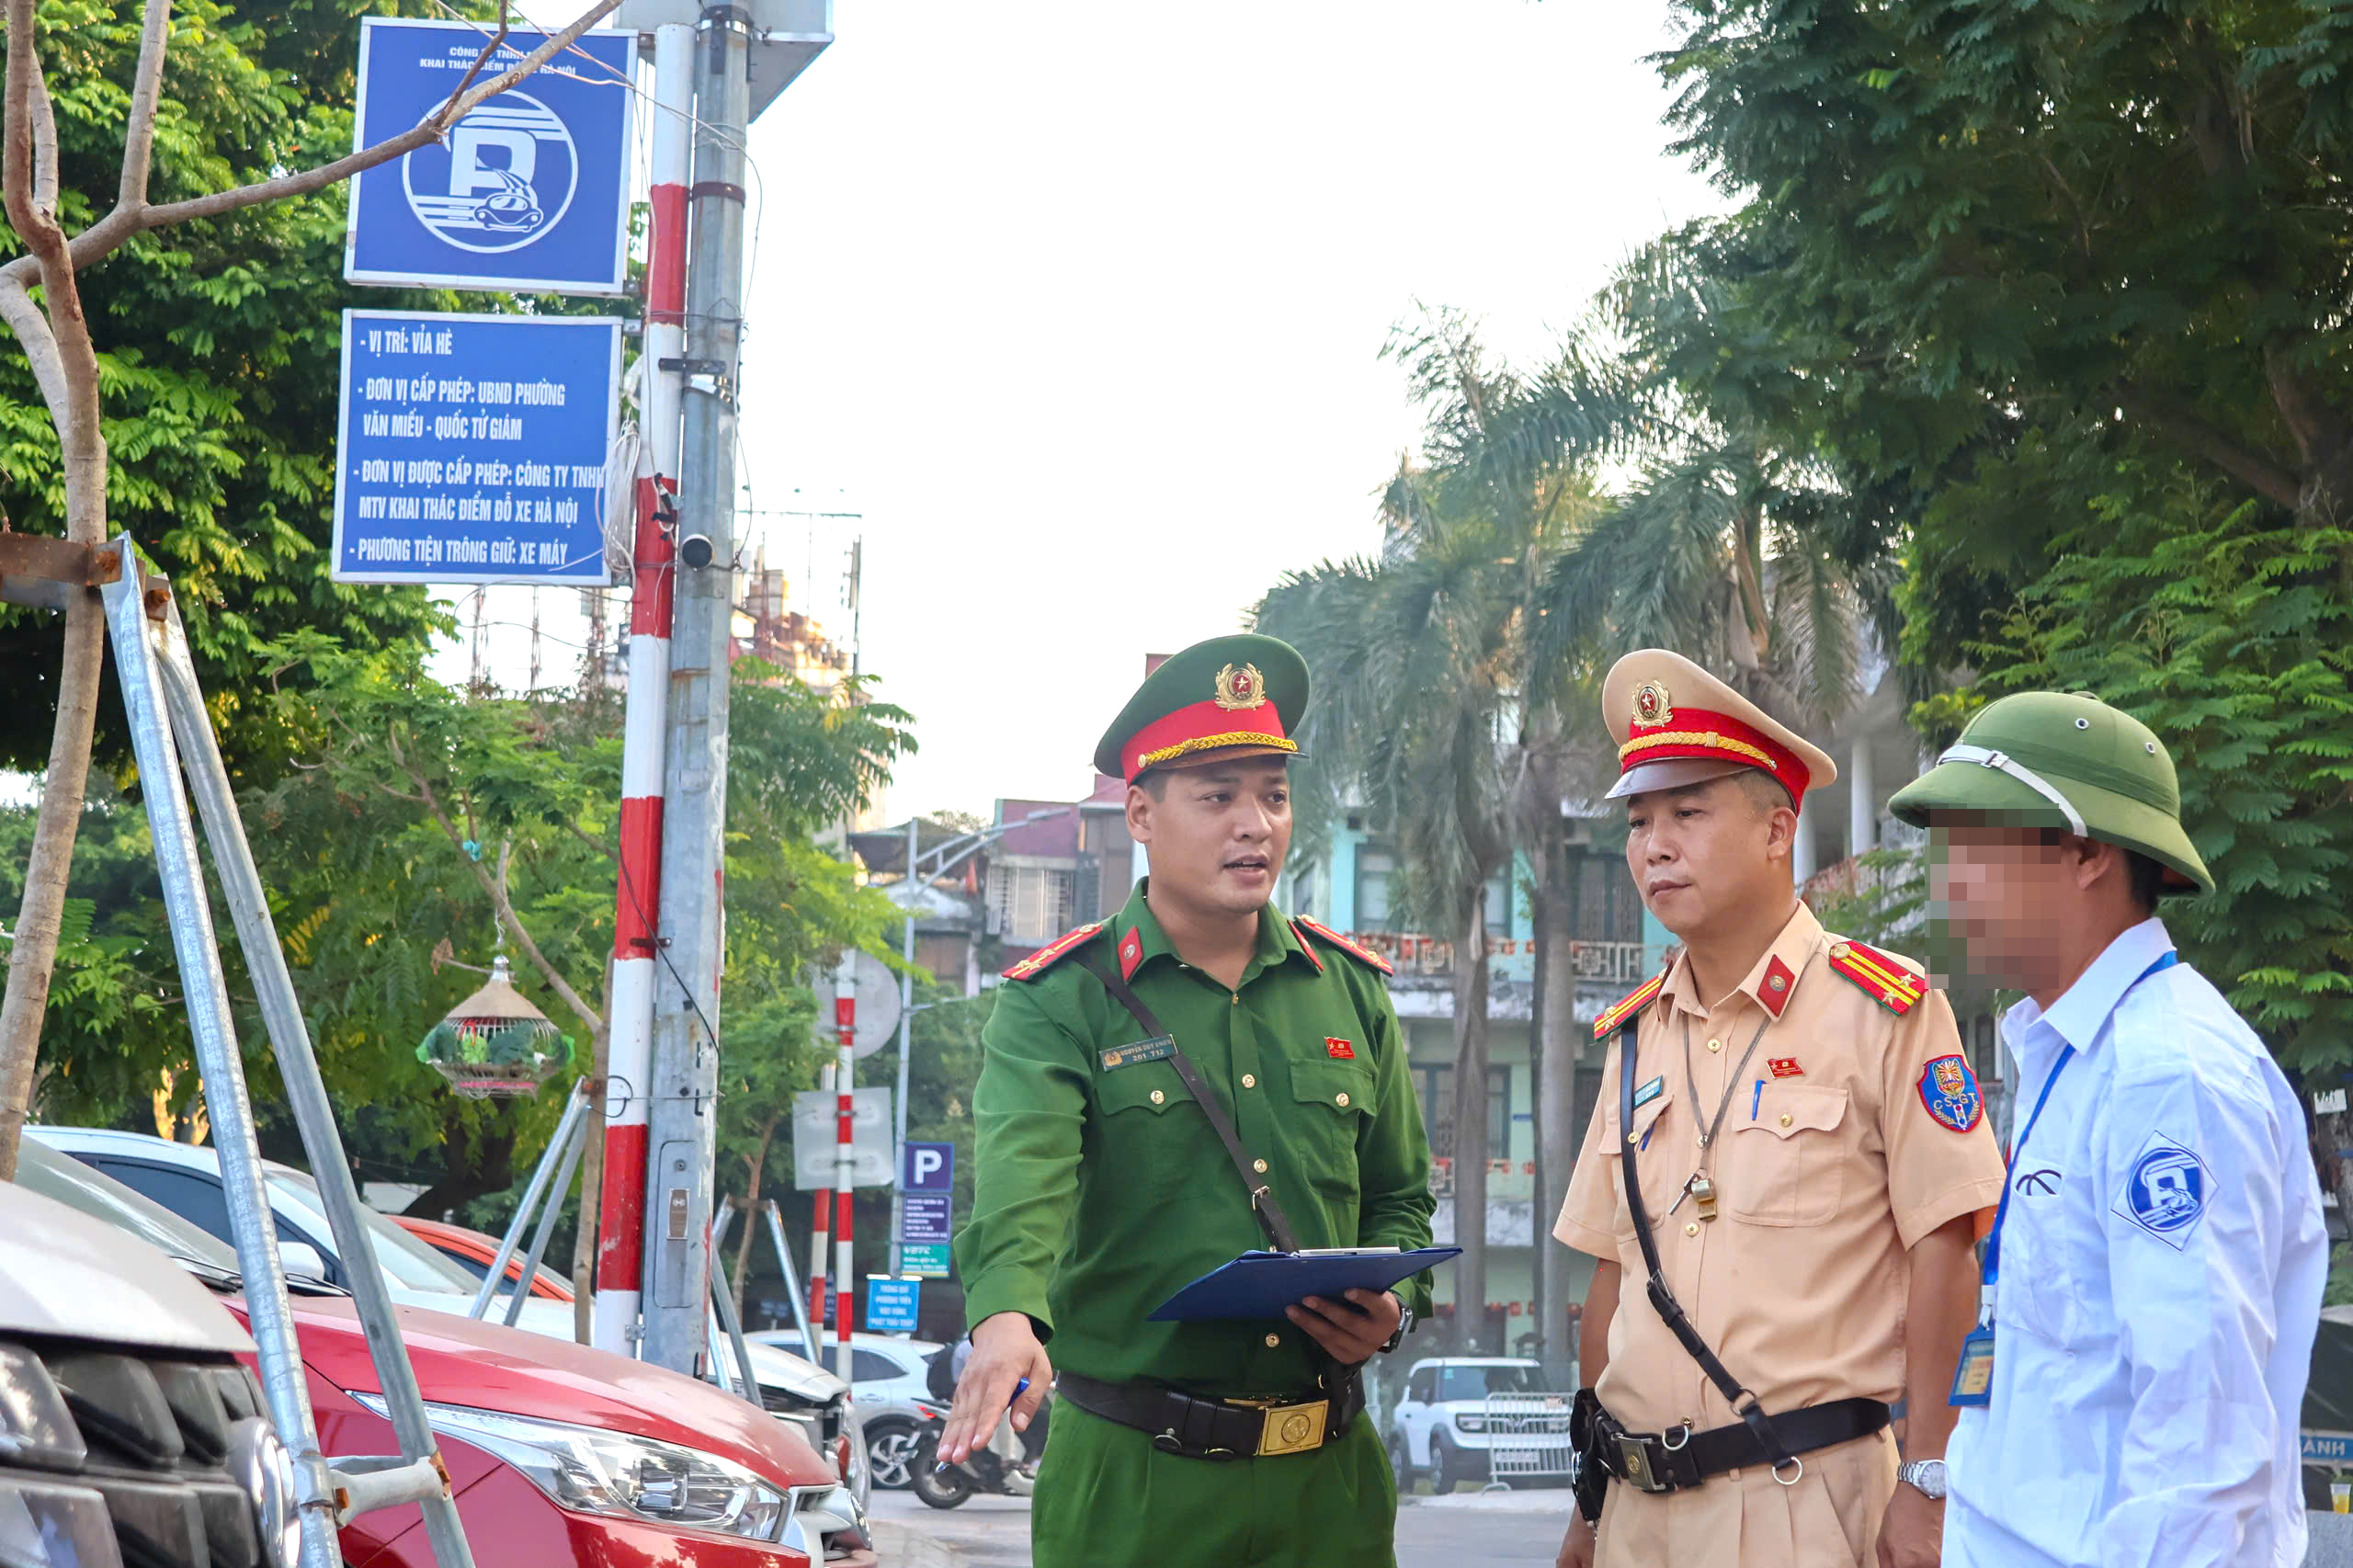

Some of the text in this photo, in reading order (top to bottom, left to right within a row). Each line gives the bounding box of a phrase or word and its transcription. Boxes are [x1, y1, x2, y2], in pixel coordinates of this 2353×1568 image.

[419, 58, 446, 67] KHAI
[449, 46, 478, 57] CÔNG
[369, 330, 381, 358] VỊ
[384, 326, 409, 354] TRÍ:
[412, 324, 433, 355] VỈA
[436, 327, 453, 356] HÈ
[366, 376, 392, 401] ĐƠN
[395, 378, 408, 406] VỊ
[410, 370, 437, 403] CẤP
[438, 374, 475, 403] PHÉP:
[478, 381, 513, 404] UBND
[515, 377, 566, 406] PHƯỜNG
[363, 409, 389, 437] VĂN
[392, 407, 424, 438] MIẾU
[435, 408, 469, 442] QUỐC
[472, 407, 490, 440] TỬ
[489, 414, 523, 441] GIÁM
[361, 458, 390, 483] ĐƠN
[392, 460, 405, 489] VỊ
[407, 459, 443, 490] ĐƯỢC
[446, 453, 472, 485] CẤP
[474, 459, 512, 486] PHÉP:
[515, 459, 551, 488] CÔNG
[553, 464, 569, 488] TY
[571, 466, 605, 489] TNHH
[358, 489, 579, 529] MTV KHAI THÁC ĐIỂM ĐỖ XE HÀ NỘI
[358, 536, 412, 562] PHƯƠNG
[414, 534, 443, 567] TIỆN
[445, 535, 488, 563] TRÔNG
[490, 536, 517, 564] GIỮ:
[518, 541, 537, 565] XE
[539, 538, 569, 566] MÁY
[914, 1149, 942, 1184] P
